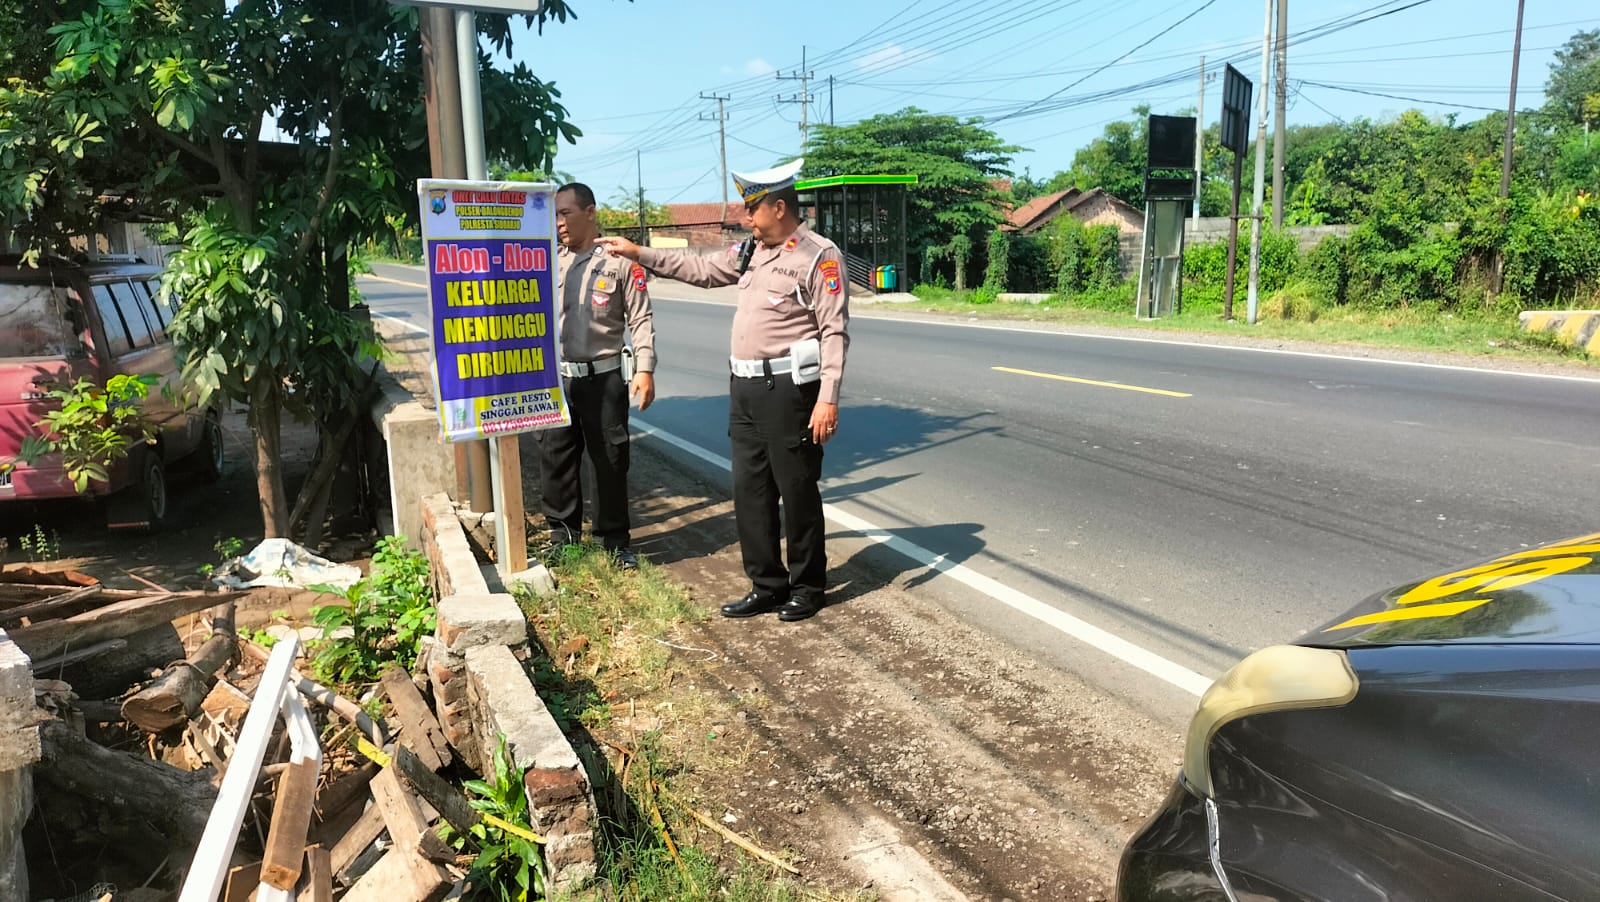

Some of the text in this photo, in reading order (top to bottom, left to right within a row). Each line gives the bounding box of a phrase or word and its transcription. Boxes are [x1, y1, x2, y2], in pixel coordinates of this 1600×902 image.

[452, 190, 527, 204] UNIT LALU LINTAS
[455, 205, 480, 217] POLSEK
[460, 218, 493, 230] POLRESTA
[435, 244, 489, 274] Alon
[504, 243, 547, 272] Alon
[772, 266, 798, 278] POLRI
[446, 278, 540, 307] KELUARGA
[443, 312, 546, 344] MENUNGGU
[456, 347, 545, 380] DIRUMAH
[491, 392, 551, 408] CAFE RESTO
[480, 401, 559, 420] SINGGAH SAWAH
